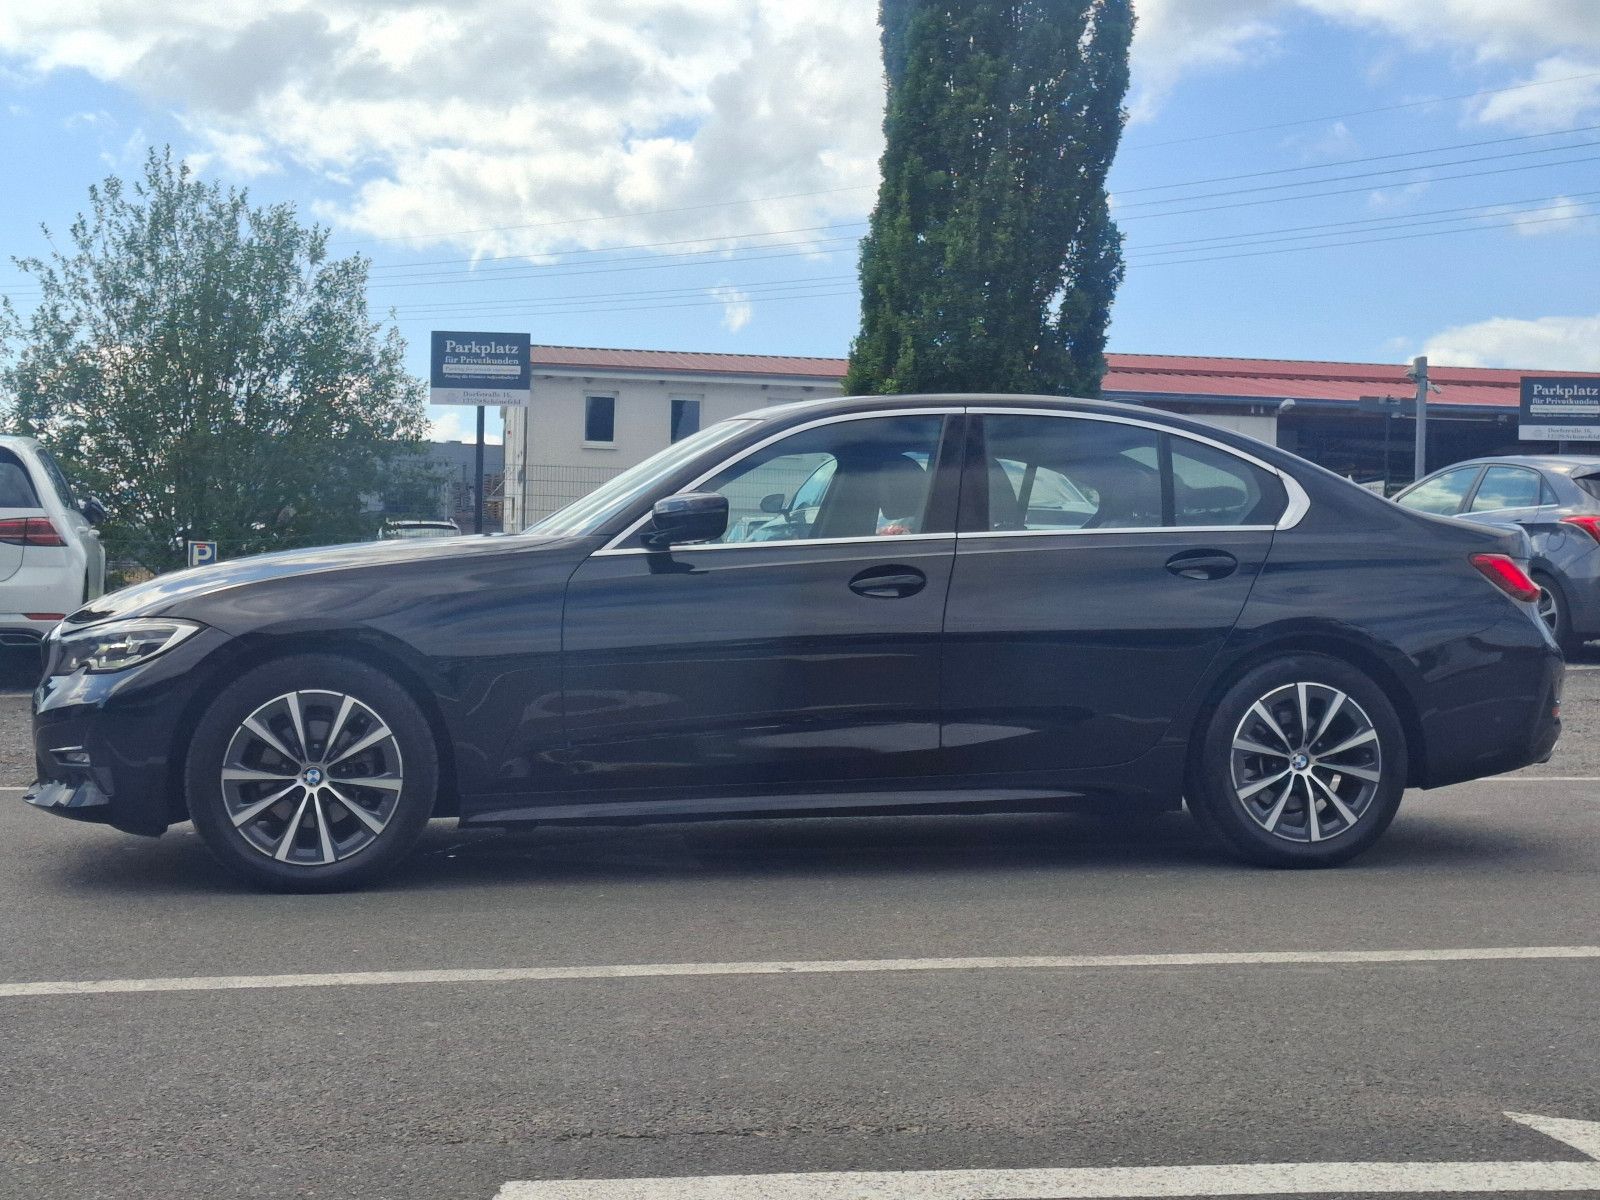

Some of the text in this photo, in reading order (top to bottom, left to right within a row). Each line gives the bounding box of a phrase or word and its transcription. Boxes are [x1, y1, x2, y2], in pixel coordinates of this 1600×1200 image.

[445, 340, 519, 357] Parkplatz
[445, 355, 519, 365] für Privatkunden
[1533, 384, 1599, 398] Parkplatz
[1546, 397, 1599, 405] Privatkunden
[193, 544, 212, 566] P
